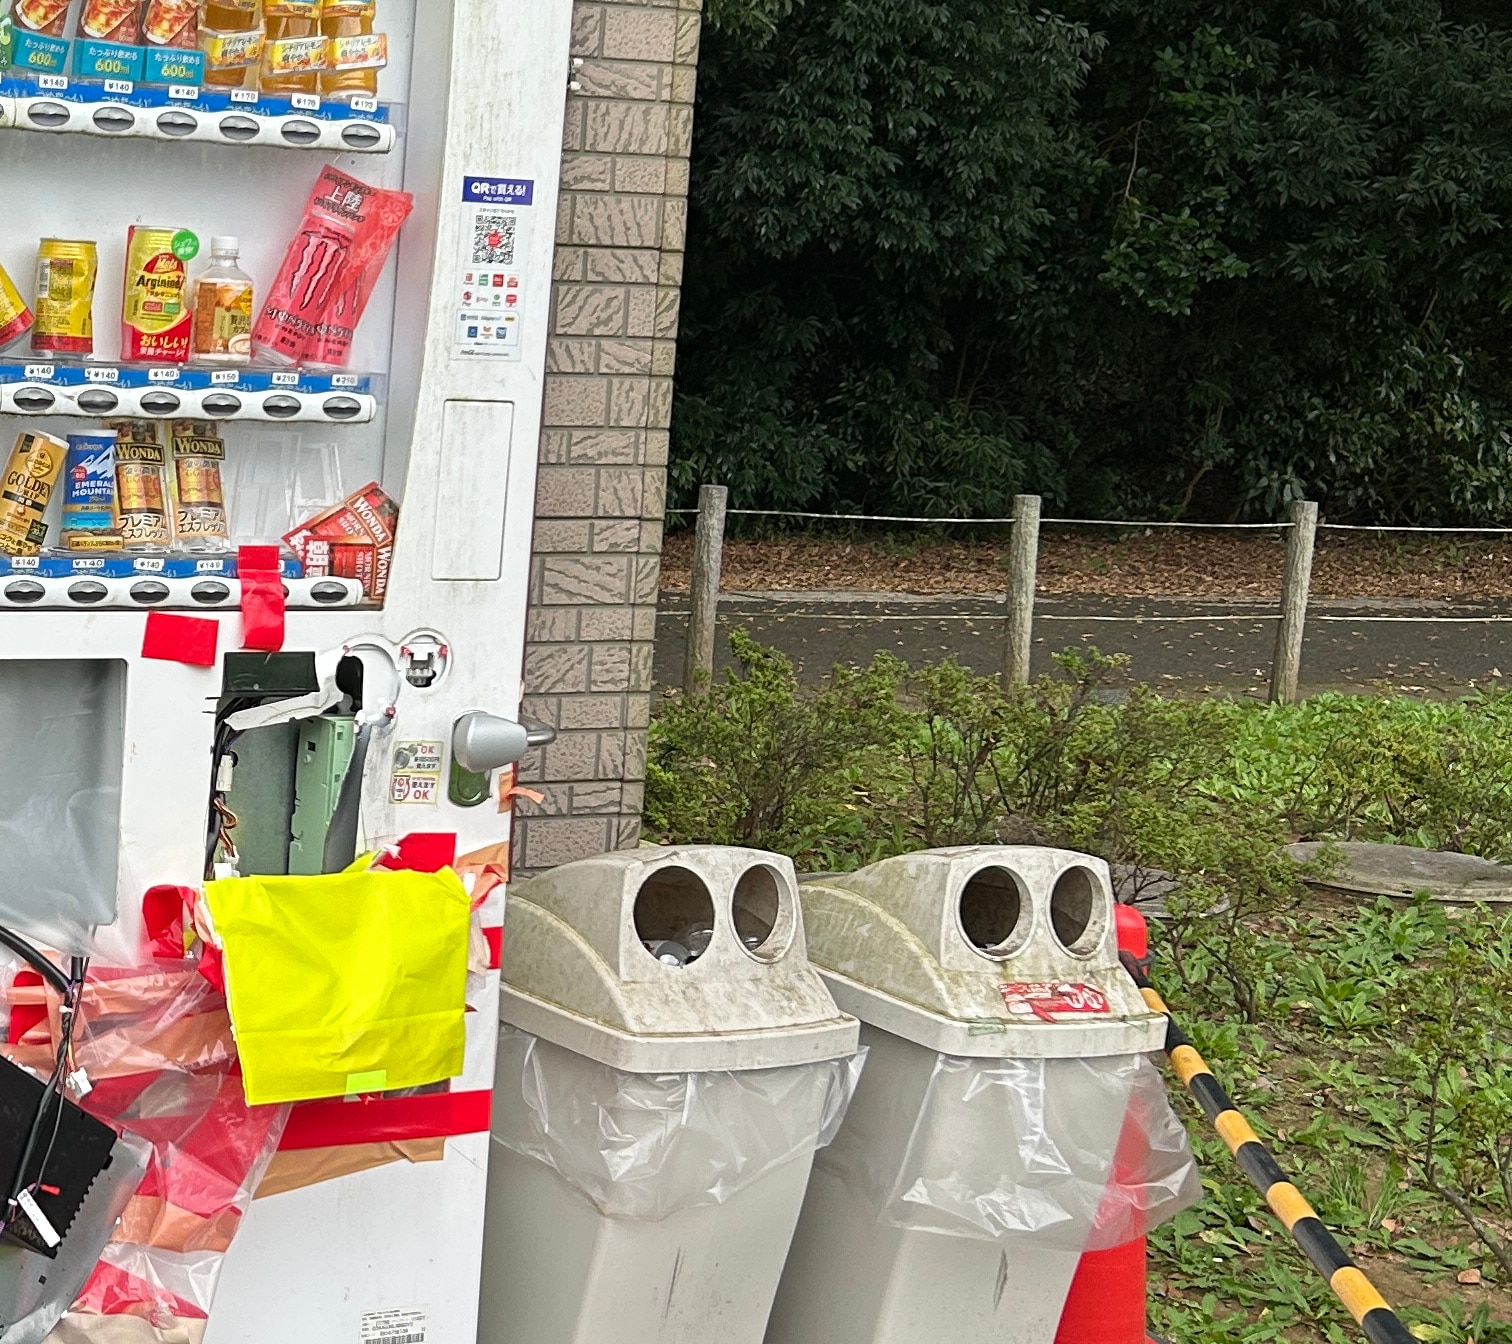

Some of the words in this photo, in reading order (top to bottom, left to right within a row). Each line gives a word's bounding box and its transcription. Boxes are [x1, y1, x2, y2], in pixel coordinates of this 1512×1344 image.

[24, 38, 65, 54] たっぷり飲める
[88, 46, 138, 61] たっぷり飲める
[154, 52, 201, 66] たっぷり飲める
[94, 59, 130, 75] 600ml
[160, 64, 194, 78] 600ml
[42, 78, 65, 88] ¥140
[107, 82, 130, 92] ¥140
[174, 88, 196, 97] ¥140
[234, 92, 256, 101] ¥170
[324, 185, 363, 212] 上陸
[29, 366, 52, 375] ¥140
[93, 370, 116, 379] ¥140
[153, 370, 175, 378] ¥140
[215, 373, 237, 381] ¥150
[276, 375, 297, 383] ¥210
[177, 437, 222, 454] WONDA
[116, 444, 161, 460] WONDA
[352, 496, 386, 543] WONDA
[14, 558, 36, 566] ¥140
[376, 545, 392, 595] WONDA
[420, 745, 435, 754] OK
[413, 790, 430, 801] OK
